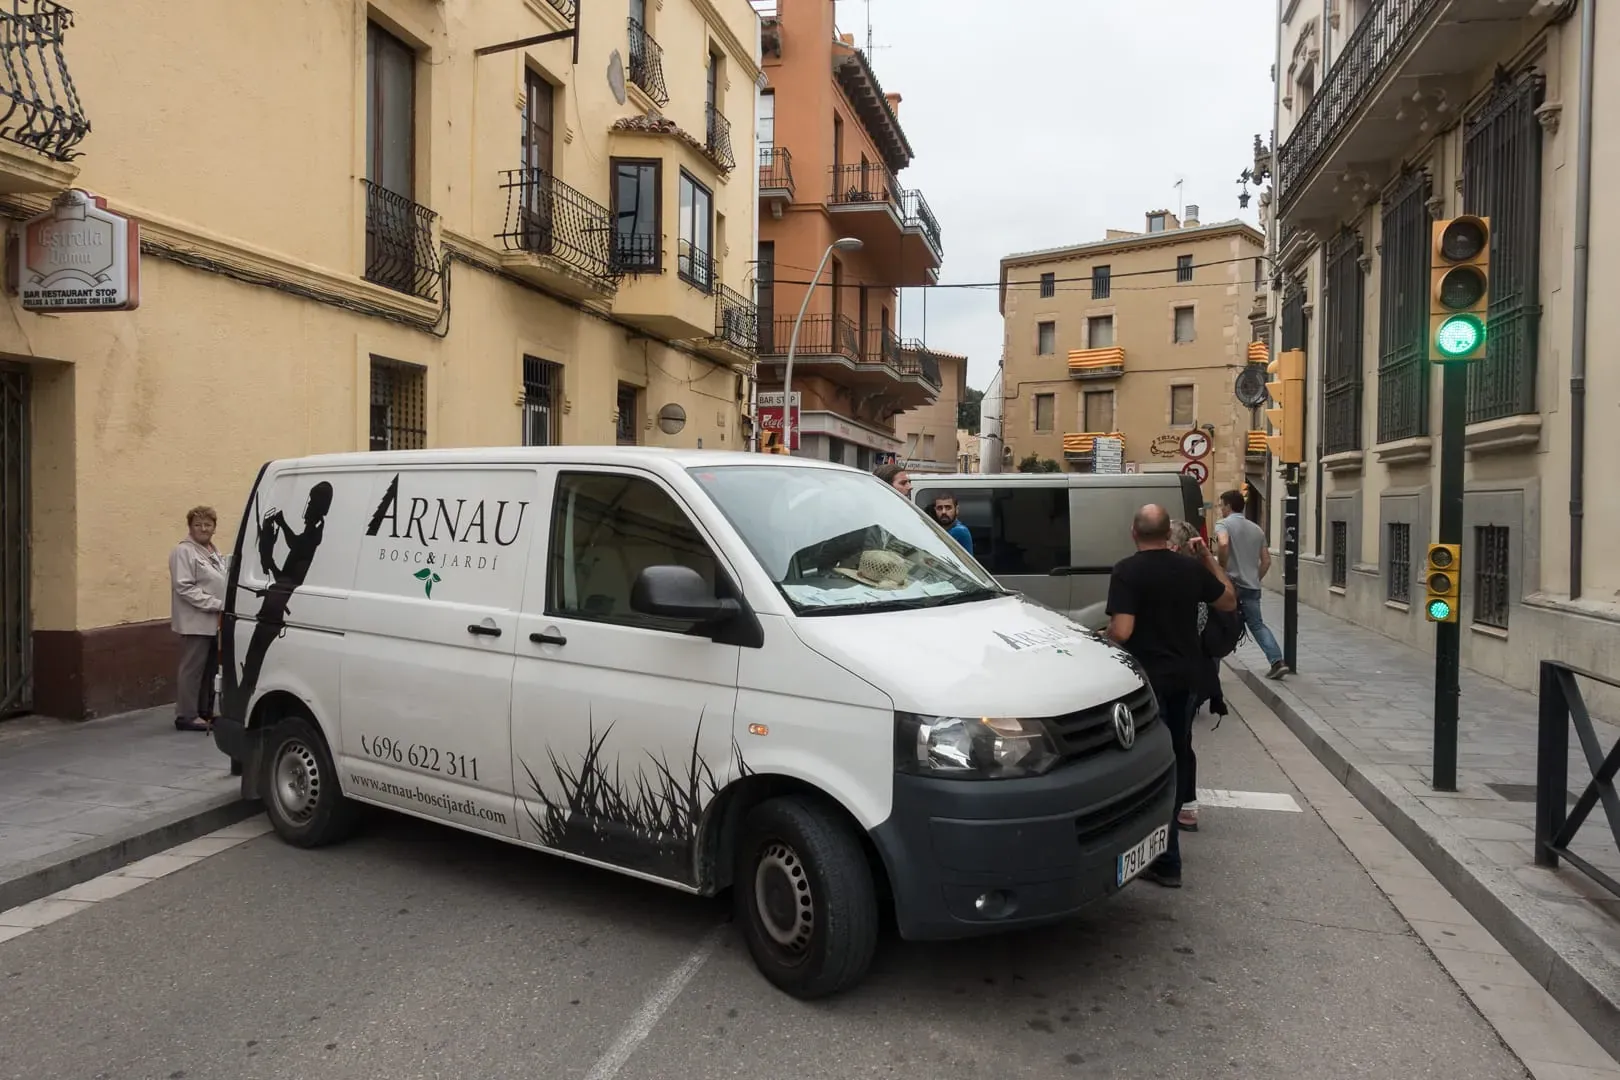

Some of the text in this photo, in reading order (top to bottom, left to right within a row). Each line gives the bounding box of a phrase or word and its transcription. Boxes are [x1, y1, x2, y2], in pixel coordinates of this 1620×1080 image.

[38, 225, 104, 248] Estrella
[23, 288, 117, 298] BAR RESTAURANT STOP
[102, 296, 116, 304] LEÑA
[759, 395, 796, 404] BAR STP
[365, 472, 530, 547] ARNAU
[373, 735, 480, 781] 696 622 311
[350, 773, 507, 825] www.arnau-boscijardi.com
[1124, 829, 1166, 879] 7912 HFR
